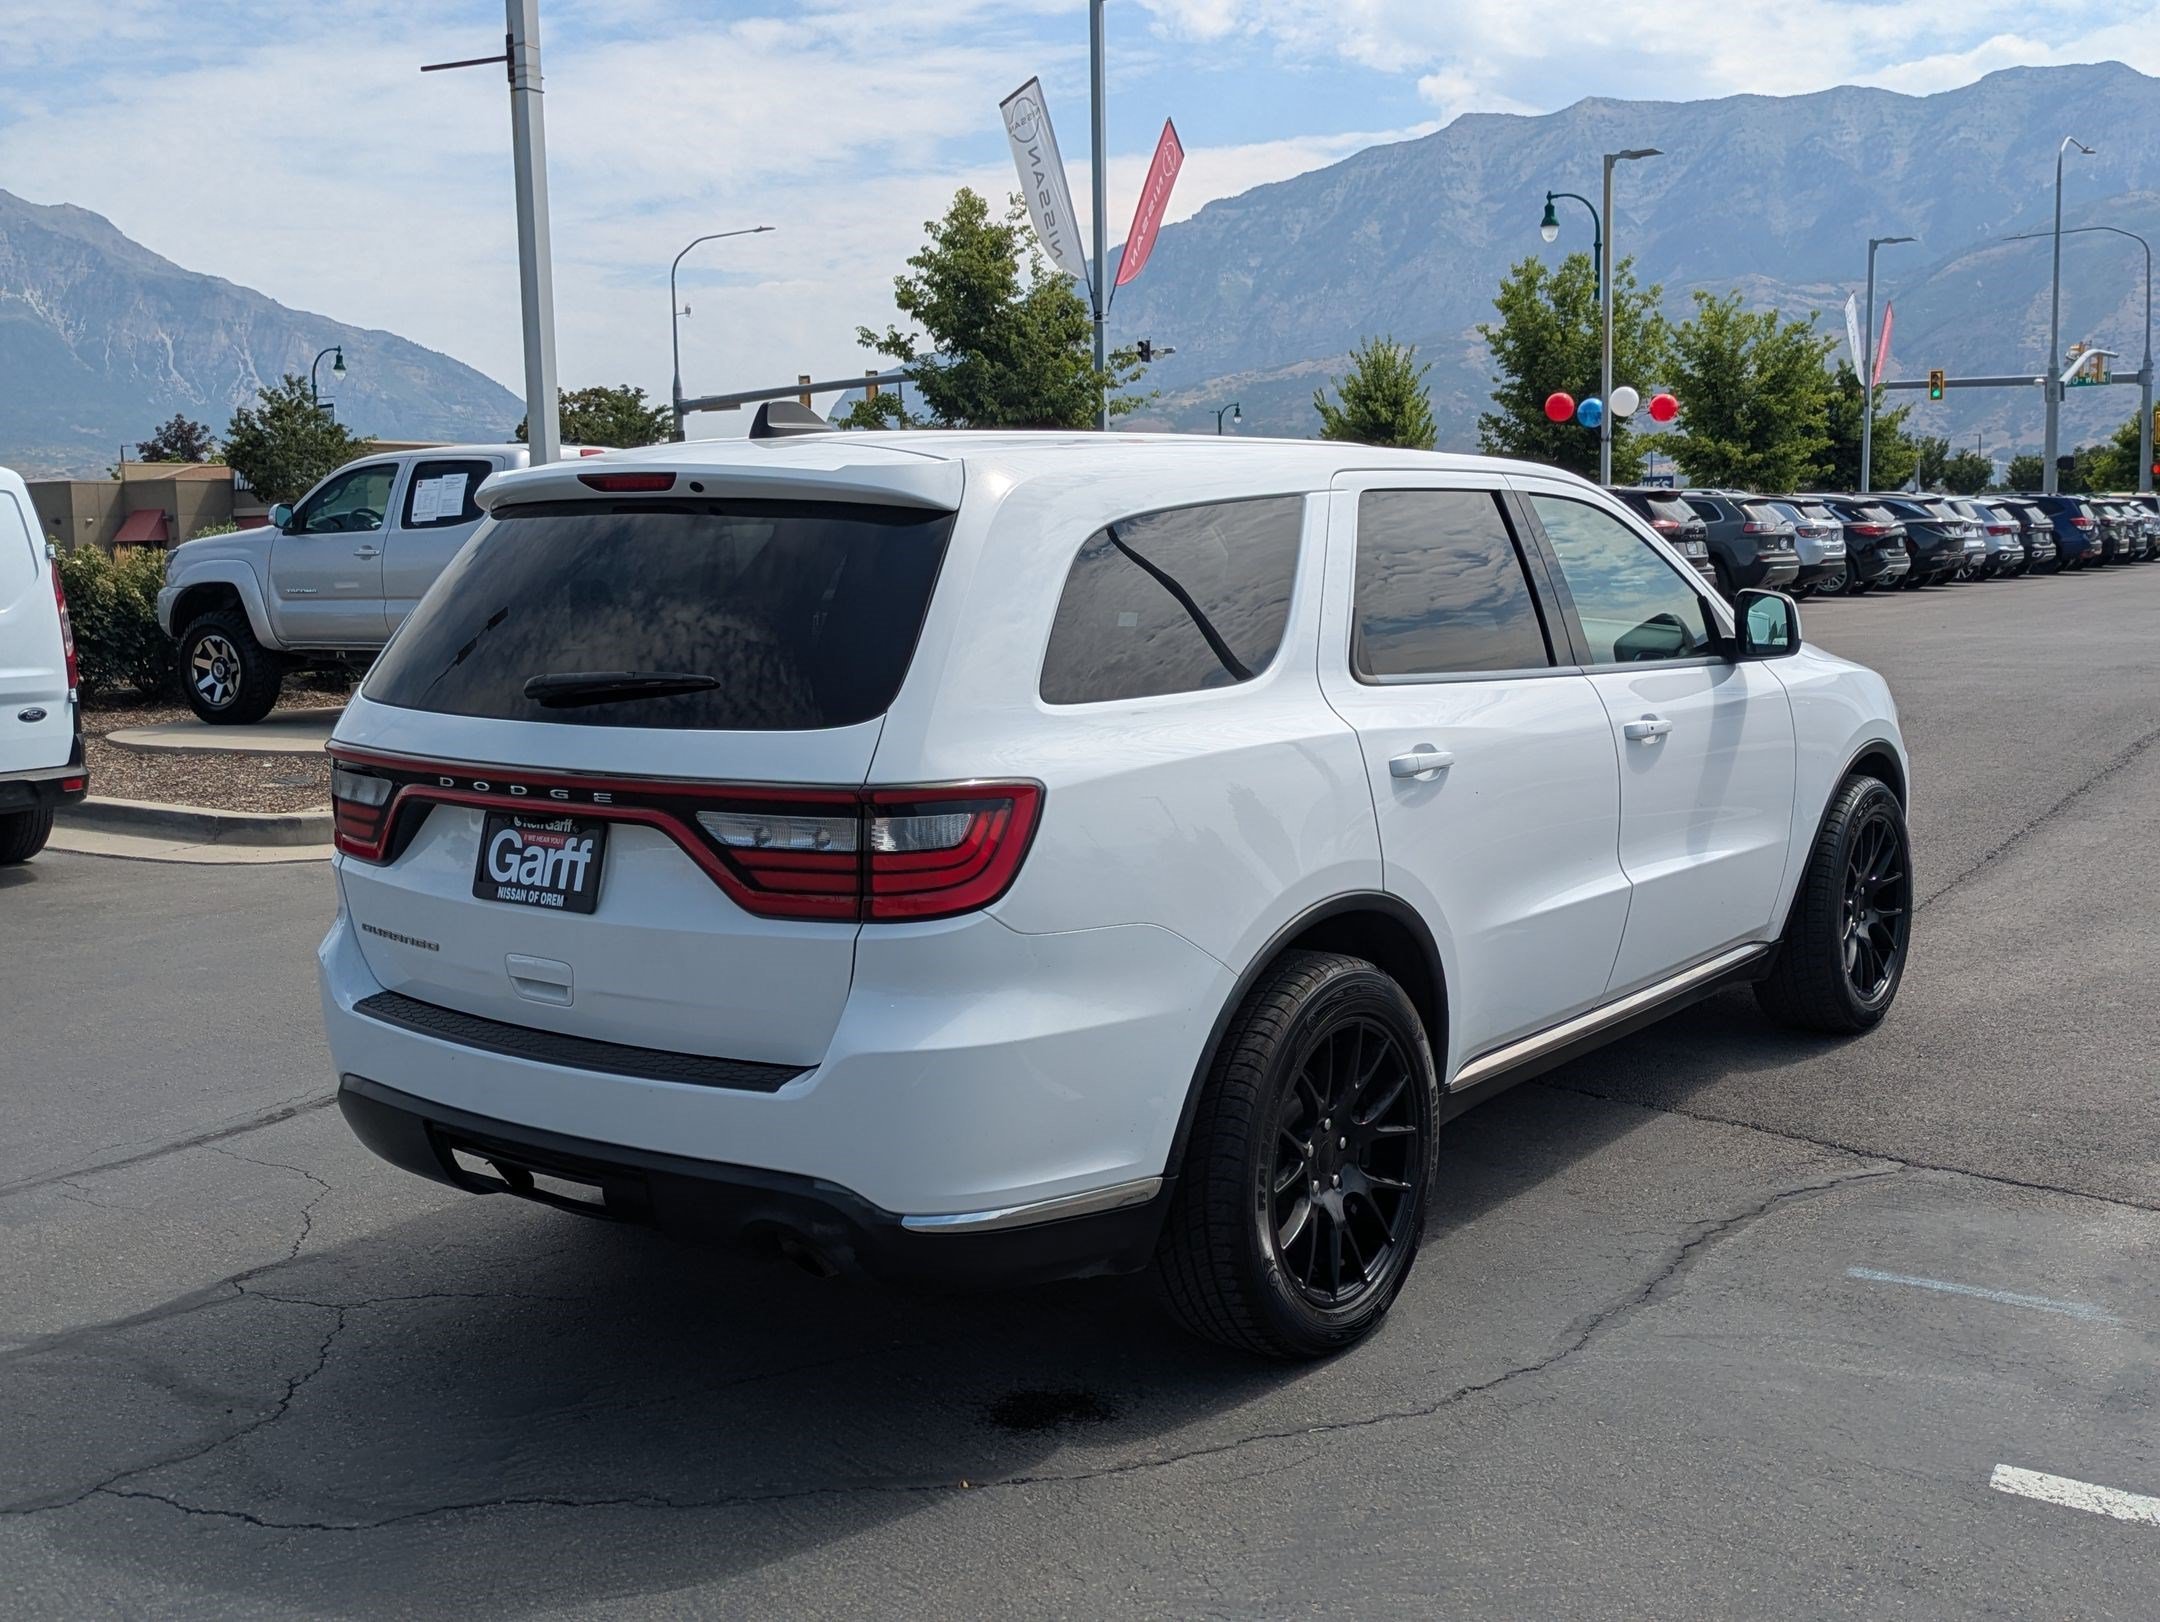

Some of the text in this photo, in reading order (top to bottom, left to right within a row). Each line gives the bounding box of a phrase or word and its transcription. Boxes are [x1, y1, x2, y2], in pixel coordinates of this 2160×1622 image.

[439, 776, 613, 803] DODGE
[488, 829, 593, 892] Garff
[497, 886, 565, 907] NISSAN OF OREM
[361, 923, 440, 952] DURANGO
